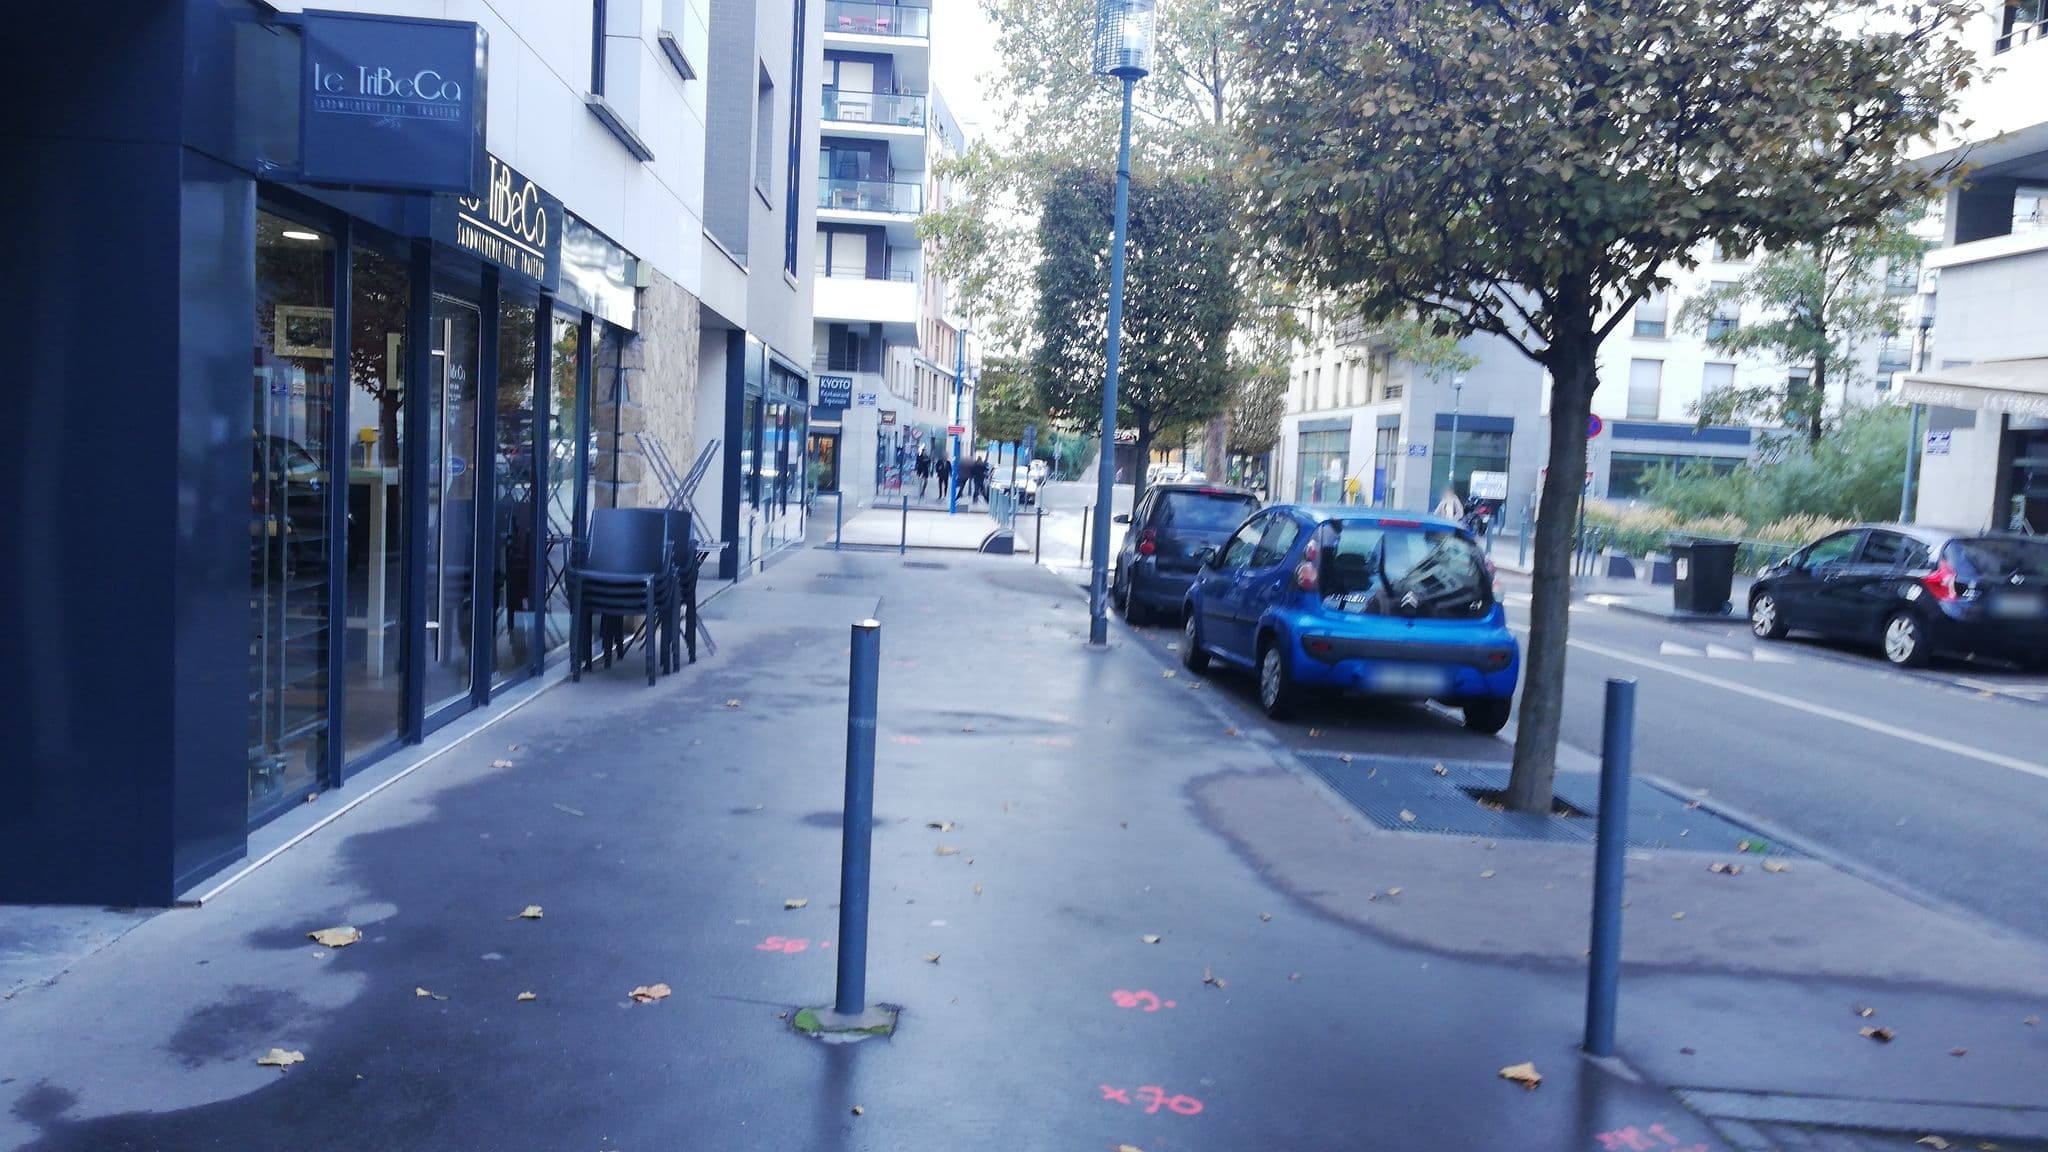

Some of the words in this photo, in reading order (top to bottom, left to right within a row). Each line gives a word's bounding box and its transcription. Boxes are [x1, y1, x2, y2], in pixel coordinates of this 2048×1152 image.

[357, 65, 461, 101] TriBeCa
[488, 156, 546, 248] TriBeCa
[820, 377, 851, 390] KYOTO
